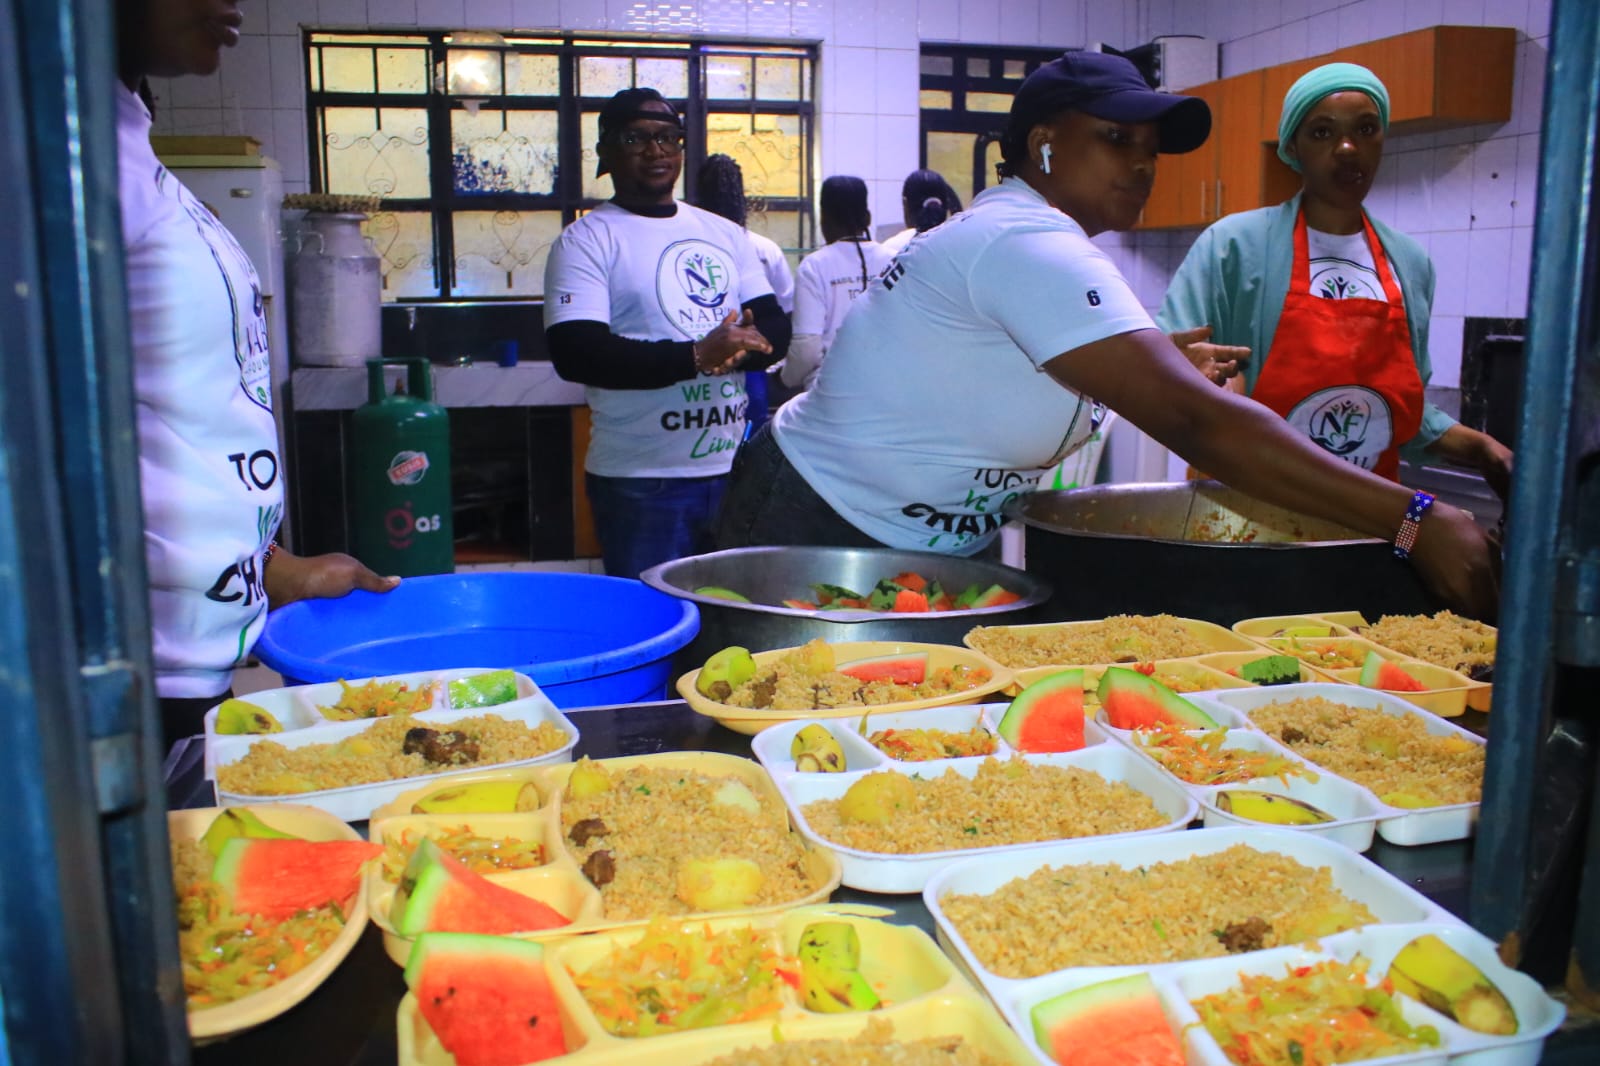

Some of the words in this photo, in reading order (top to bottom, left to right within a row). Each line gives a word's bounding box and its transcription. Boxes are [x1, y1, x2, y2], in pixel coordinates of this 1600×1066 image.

[559, 293, 572, 305] 13
[1086, 289, 1101, 307] 6
[681, 382, 711, 402] WE
